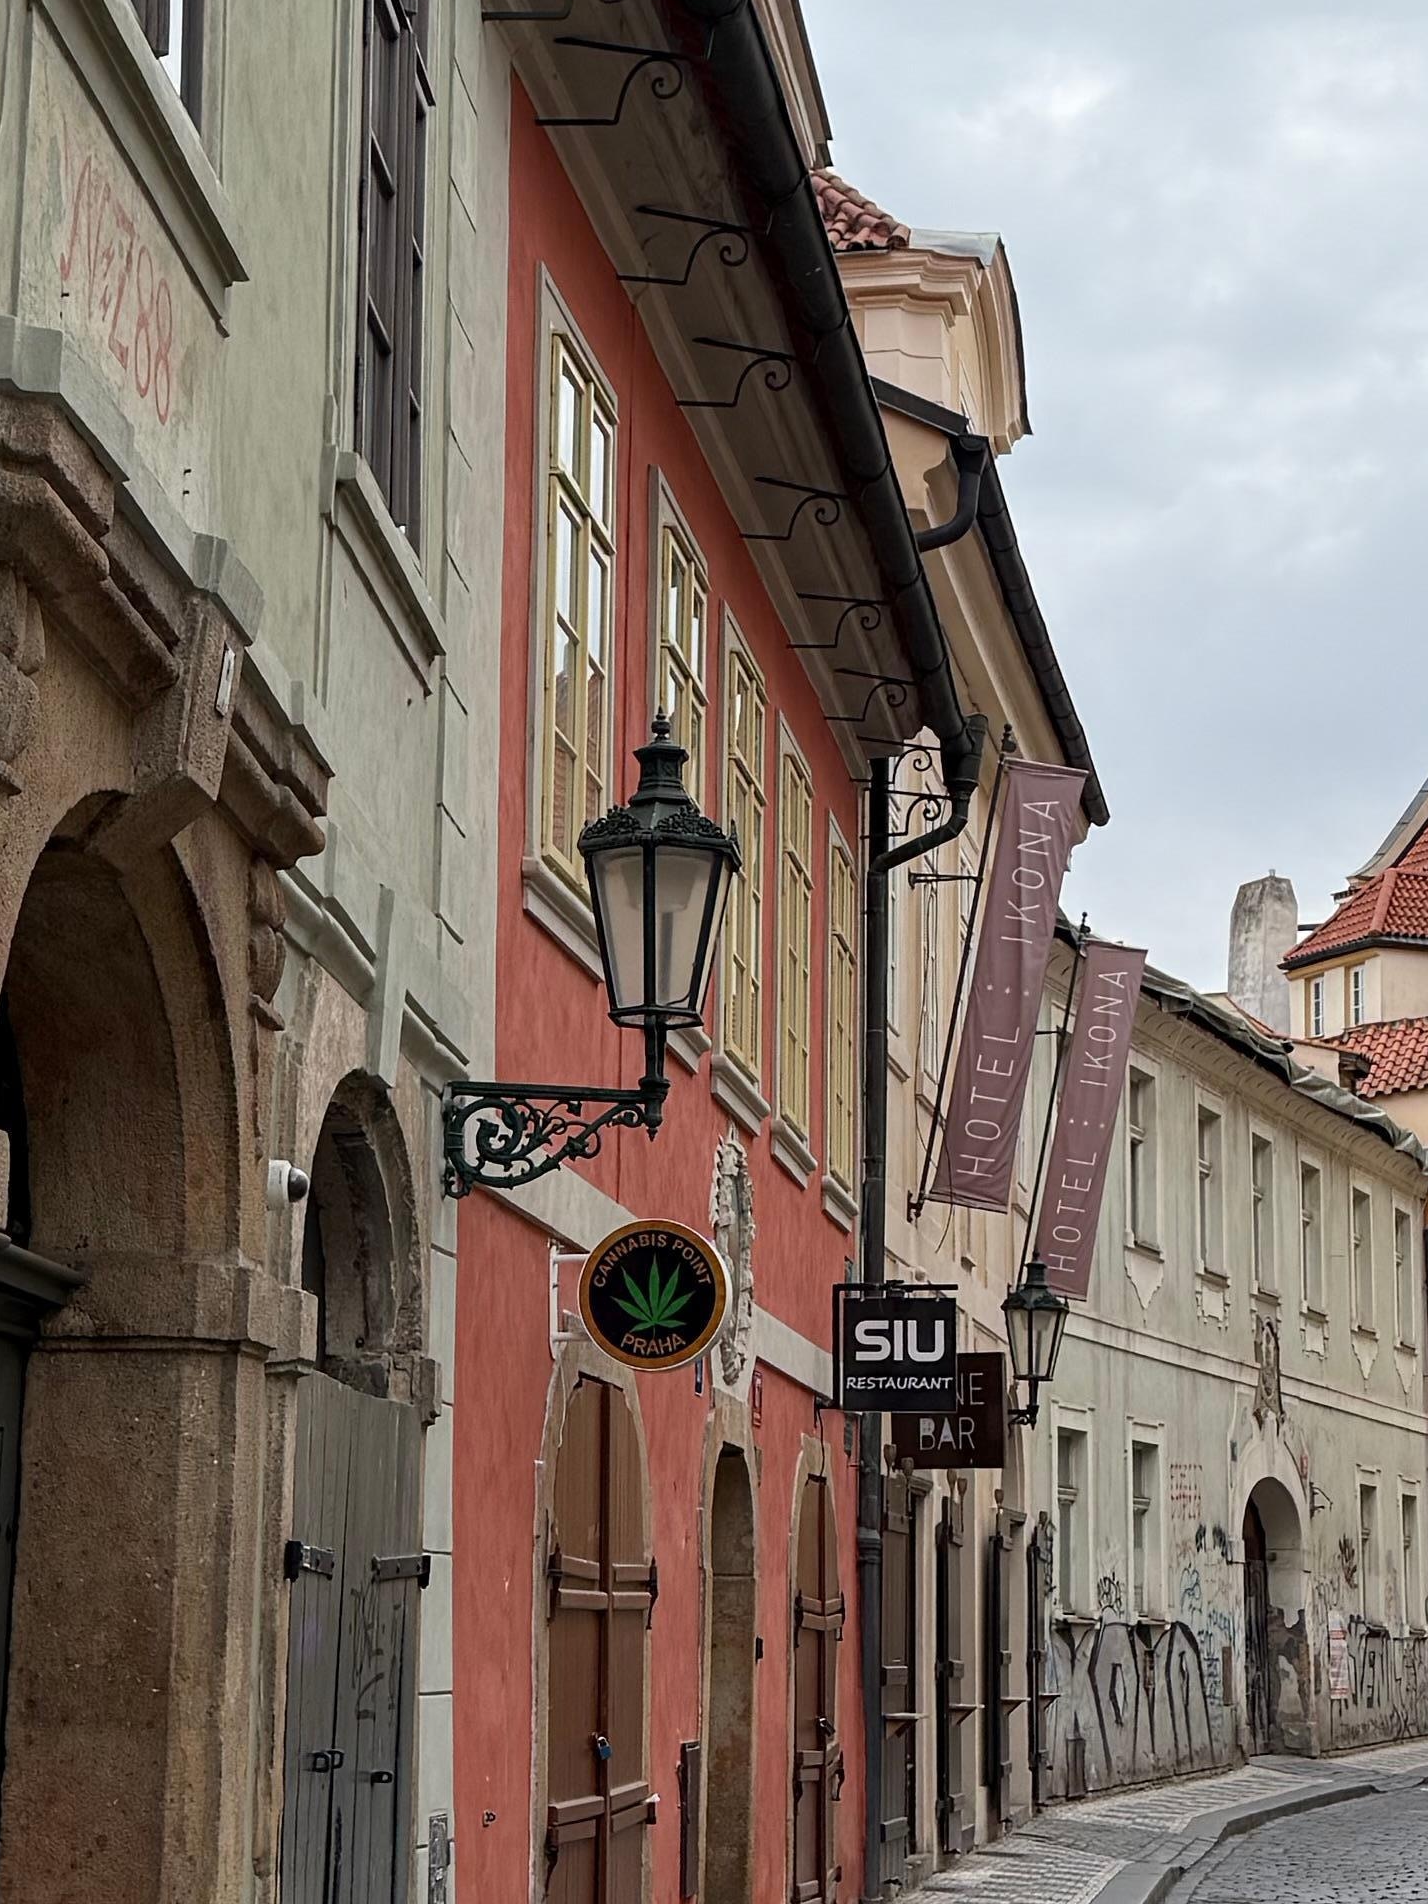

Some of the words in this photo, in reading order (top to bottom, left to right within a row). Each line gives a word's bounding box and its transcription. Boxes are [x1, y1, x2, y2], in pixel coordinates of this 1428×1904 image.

[956, 1027, 1020, 1178] HOTEL
[1001, 800, 1060, 945] IKONA
[1047, 1152, 1098, 1274] HOTEL
[1079, 971, 1129, 1088] IKONA
[593, 1233, 669, 1288] CANNABIS
[672, 1239, 712, 1286] POINT
[620, 1332, 687, 1356] PRAHA
[854, 1319, 945, 1362] SIU
[846, 1376, 954, 1390] RESTAURANT
[919, 1417, 976, 1451] BAR
